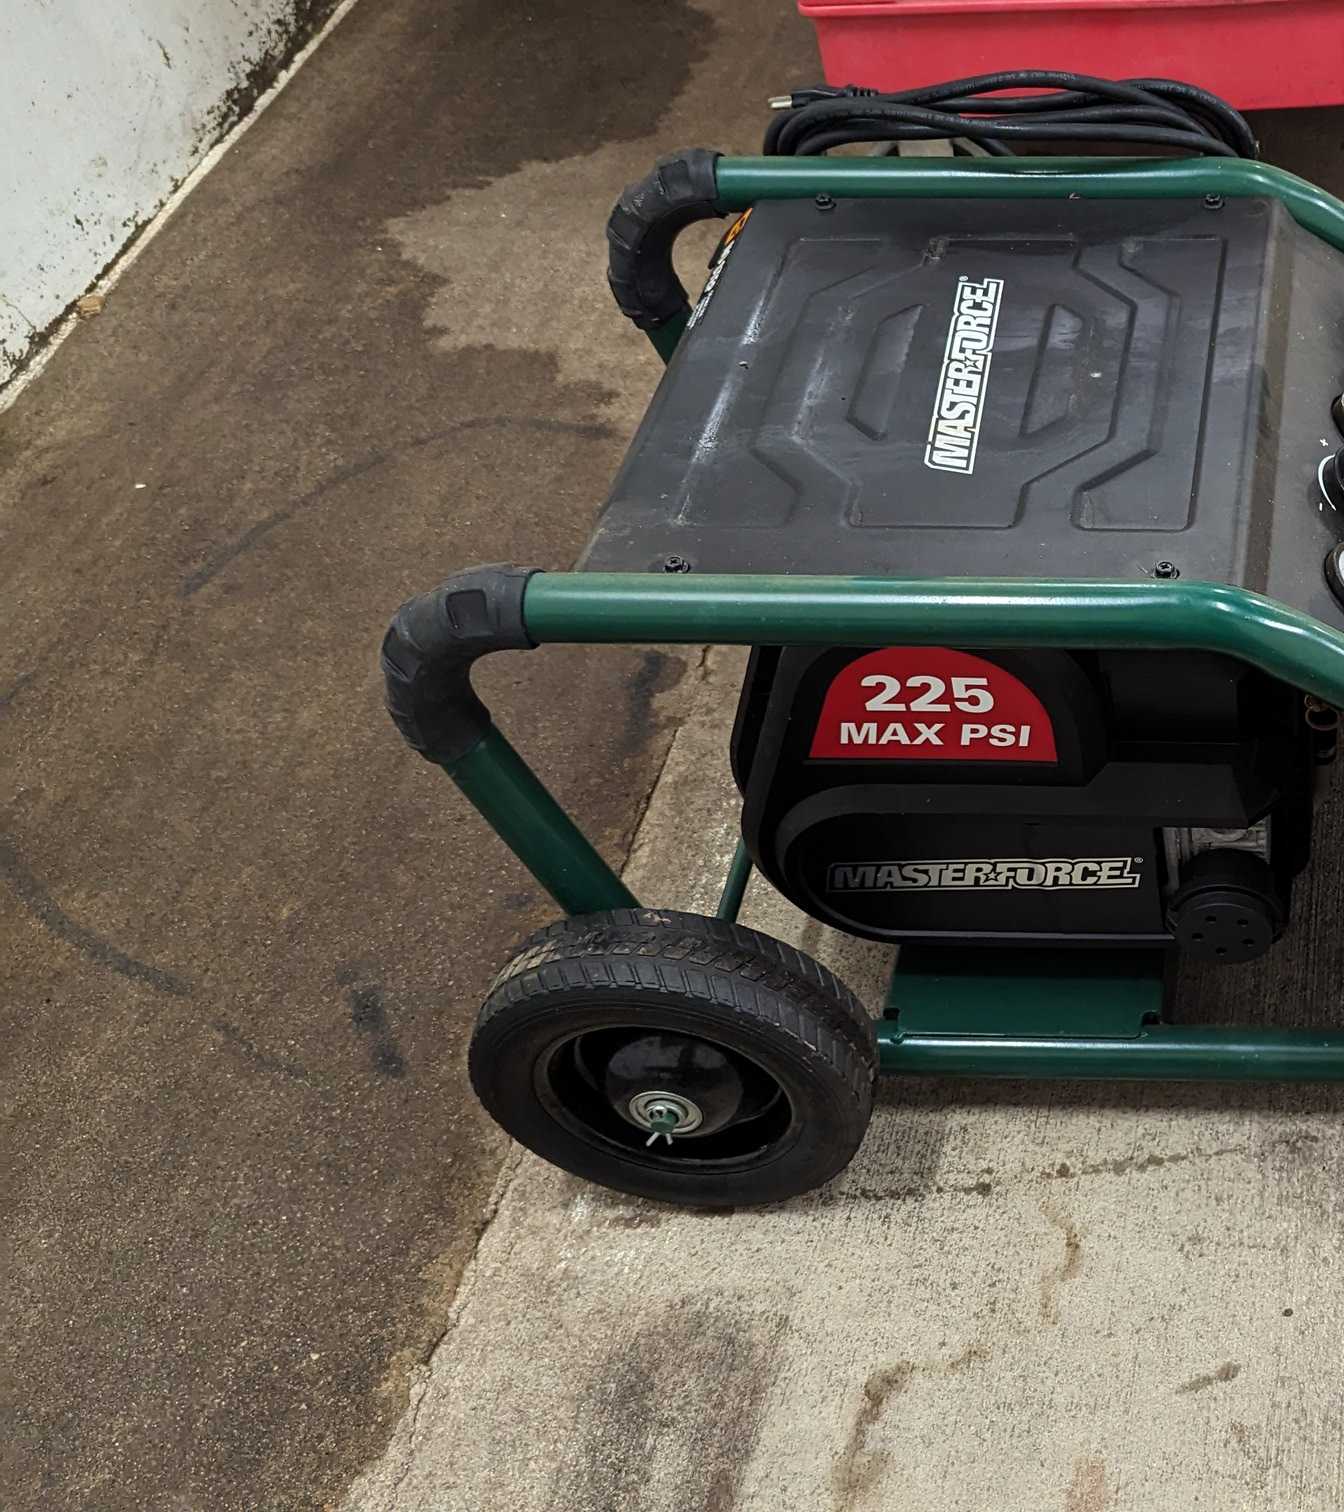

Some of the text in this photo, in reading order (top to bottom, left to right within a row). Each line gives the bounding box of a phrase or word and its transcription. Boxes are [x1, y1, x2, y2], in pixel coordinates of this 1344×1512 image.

[860, 675, 995, 713] 225
[840, 722, 1031, 747] MAX PSI
